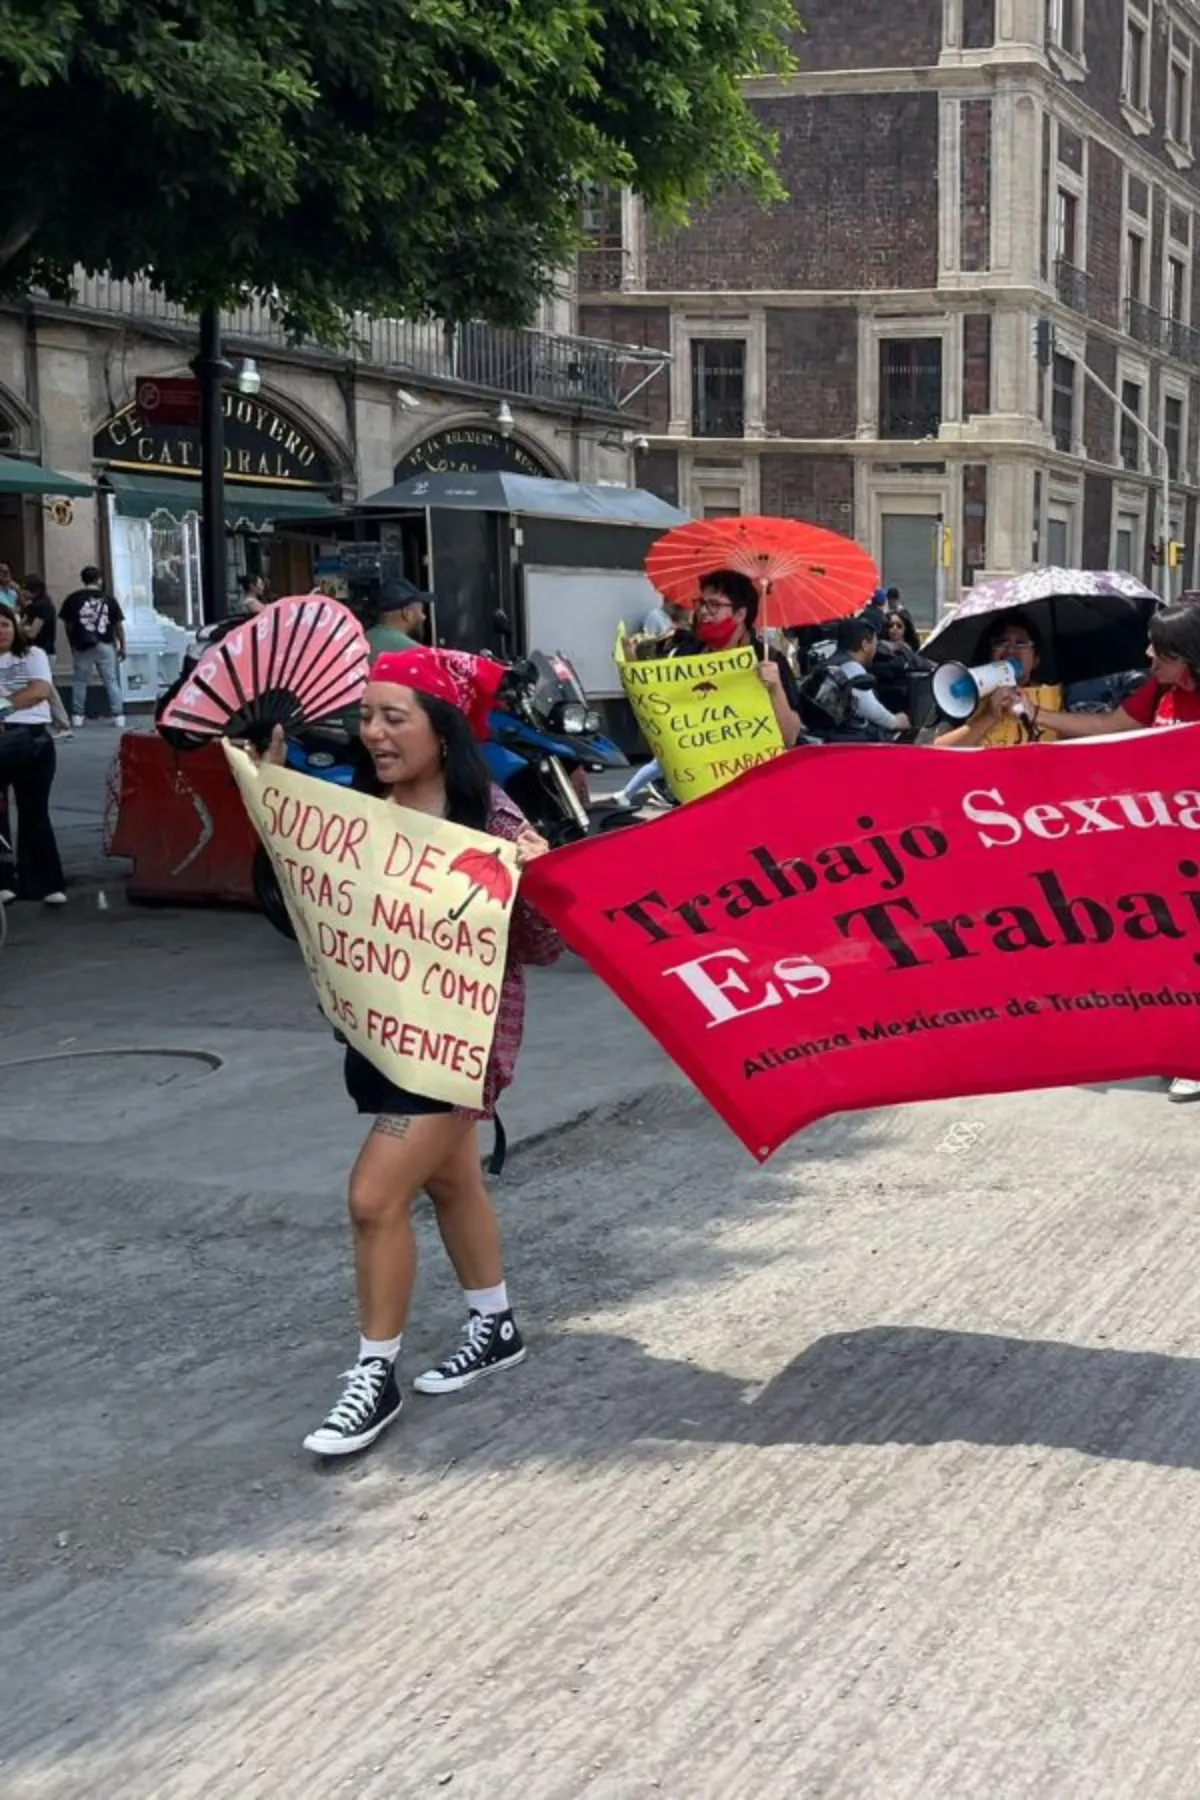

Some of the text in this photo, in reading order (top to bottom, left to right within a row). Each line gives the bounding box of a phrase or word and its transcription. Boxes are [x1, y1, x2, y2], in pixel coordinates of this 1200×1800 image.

[137, 437, 290, 477] CATDRAL
[220, 395, 316, 467] JOYERO
[677, 715, 774, 750] CUERPX
[261, 786, 447, 895] SUDOR DE
[602, 815, 950, 946] Trabajo
[317, 921, 411, 983] DIGNO
[422, 962, 499, 1017] COMO
[371, 893, 498, 967] NALGAS
[661, 947, 831, 1030] Es
[366, 1008, 486, 1081] FRENTES
[742, 1032, 851, 1080] Alianza
[856, 1003, 998, 1043] Mexicana
[1005, 997, 1041, 1018] de
